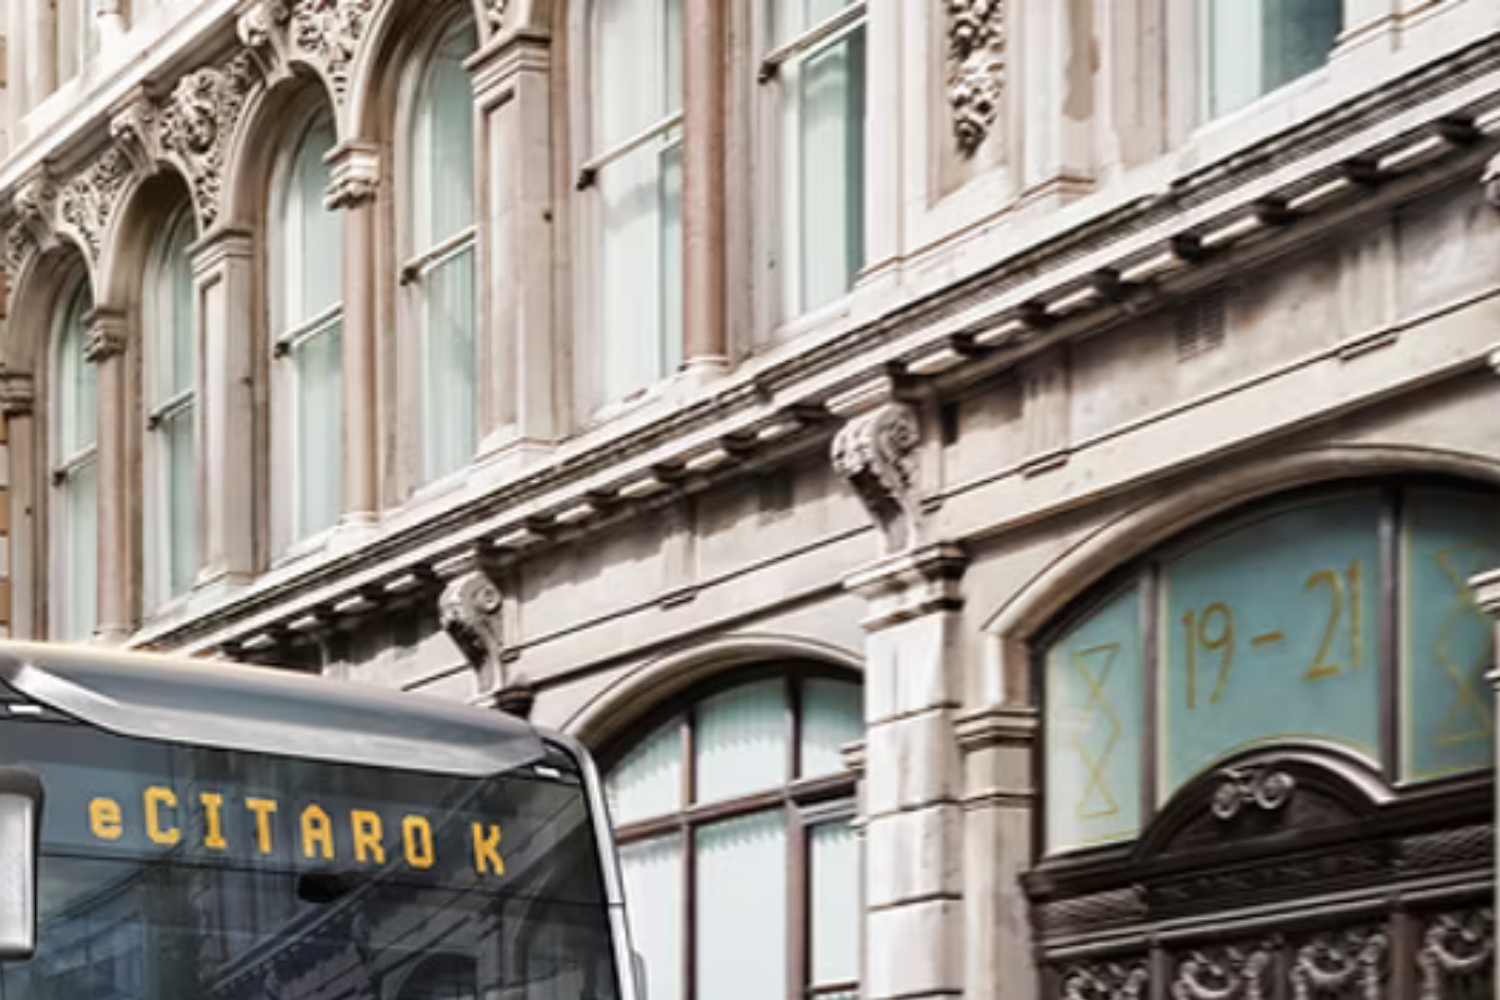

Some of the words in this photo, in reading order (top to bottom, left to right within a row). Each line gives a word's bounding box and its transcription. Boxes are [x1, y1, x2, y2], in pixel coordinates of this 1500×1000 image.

[1182, 602, 1235, 710] 19
[1301, 556, 1364, 682] 21
[88, 786, 436, 870] eCITARO
[472, 820, 506, 877] K
